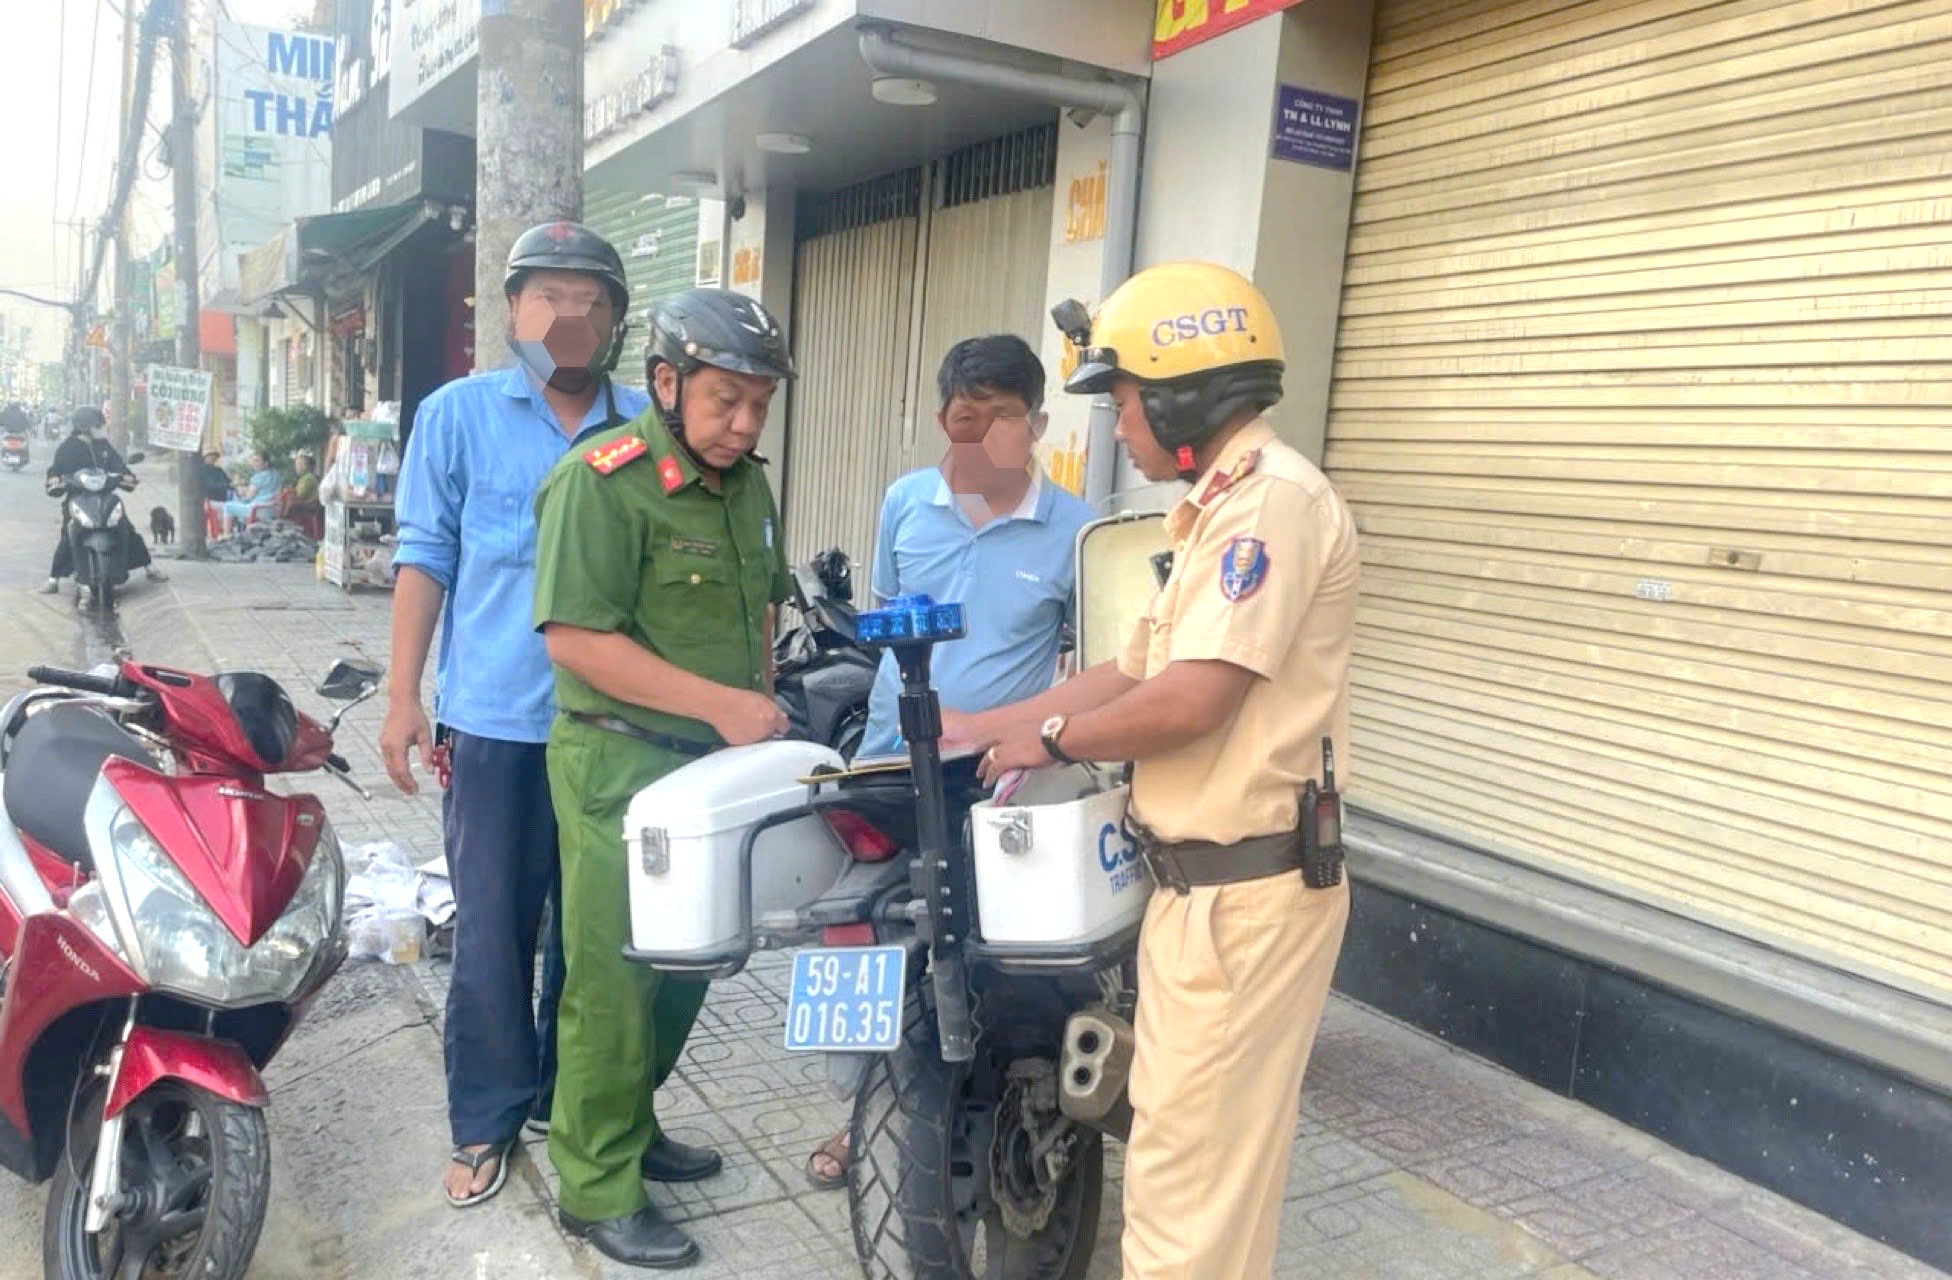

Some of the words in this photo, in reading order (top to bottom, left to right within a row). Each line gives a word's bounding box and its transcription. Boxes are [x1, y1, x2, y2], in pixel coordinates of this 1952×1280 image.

[1283, 109, 1298, 121] TN
[1300, 112, 1308, 123] &
[1310, 115, 1322, 127] LL
[1324, 118, 1351, 132] LYNH
[1152, 307, 1248, 347] CSGT
[57, 935, 100, 982] HONDA
[806, 954, 888, 996] 59-A1
[794, 1001, 893, 1043] 016.35
